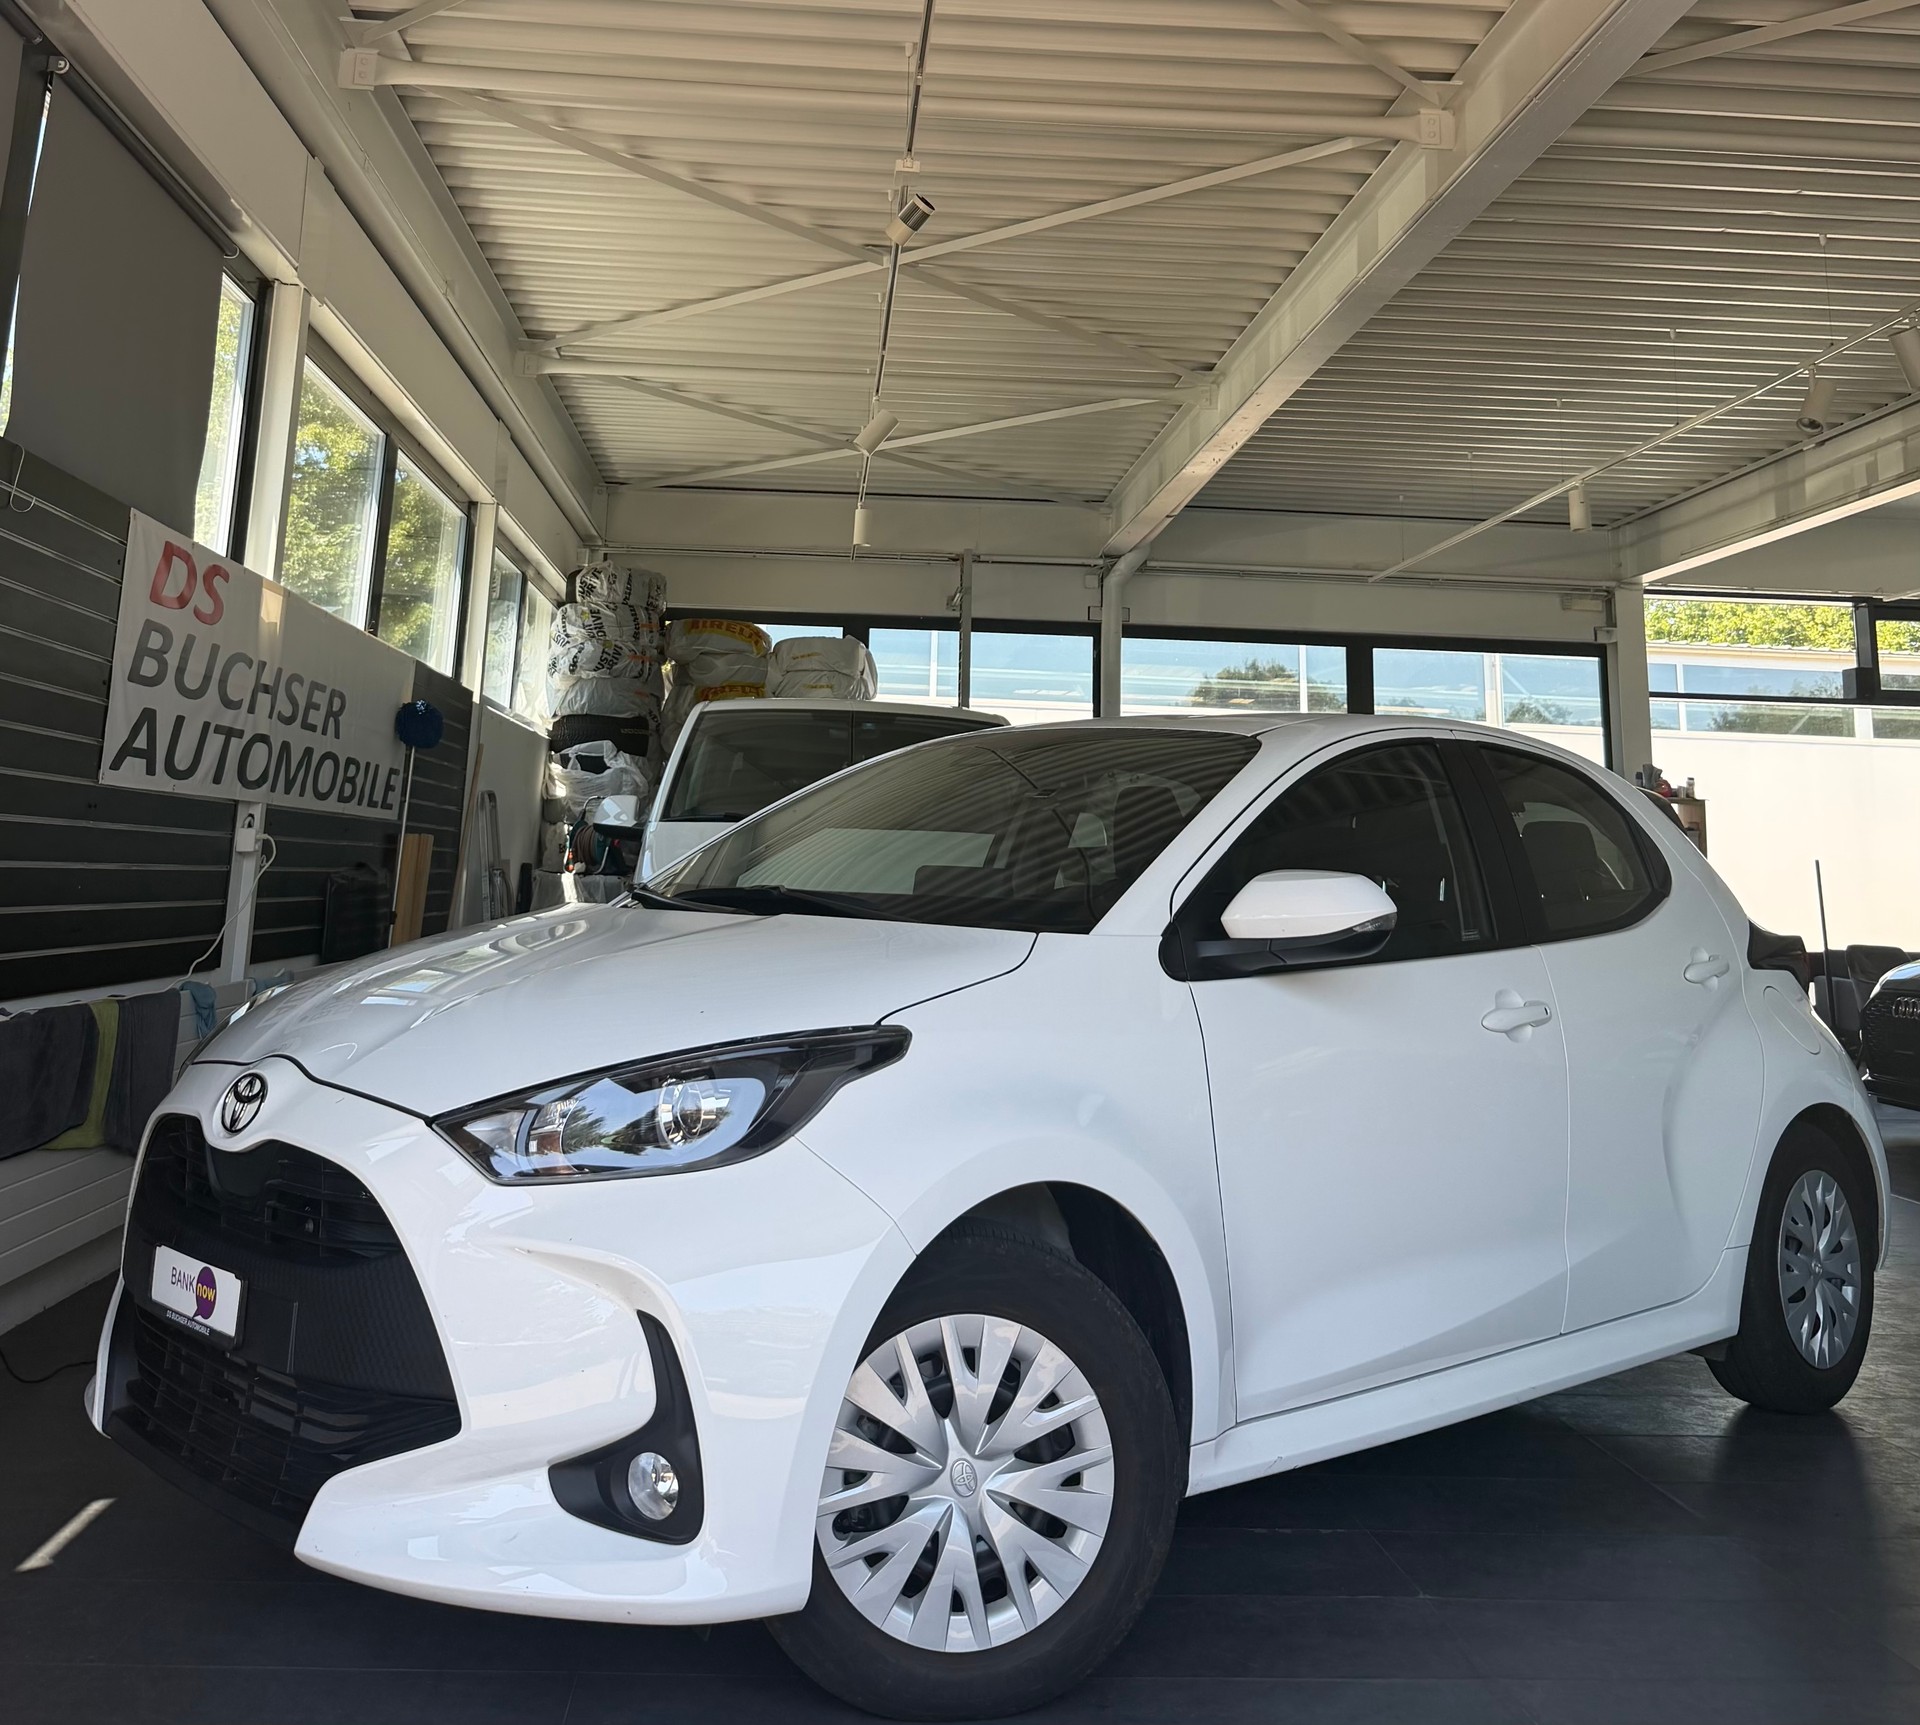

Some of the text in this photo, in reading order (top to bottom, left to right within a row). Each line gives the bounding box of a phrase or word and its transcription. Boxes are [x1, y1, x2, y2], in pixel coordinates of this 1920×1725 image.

[150, 540, 230, 625] DS
[127, 618, 347, 740] BUCHSER
[108, 706, 400, 811] AUTOMOBILE
[171, 1266, 216, 1302] BANK now
